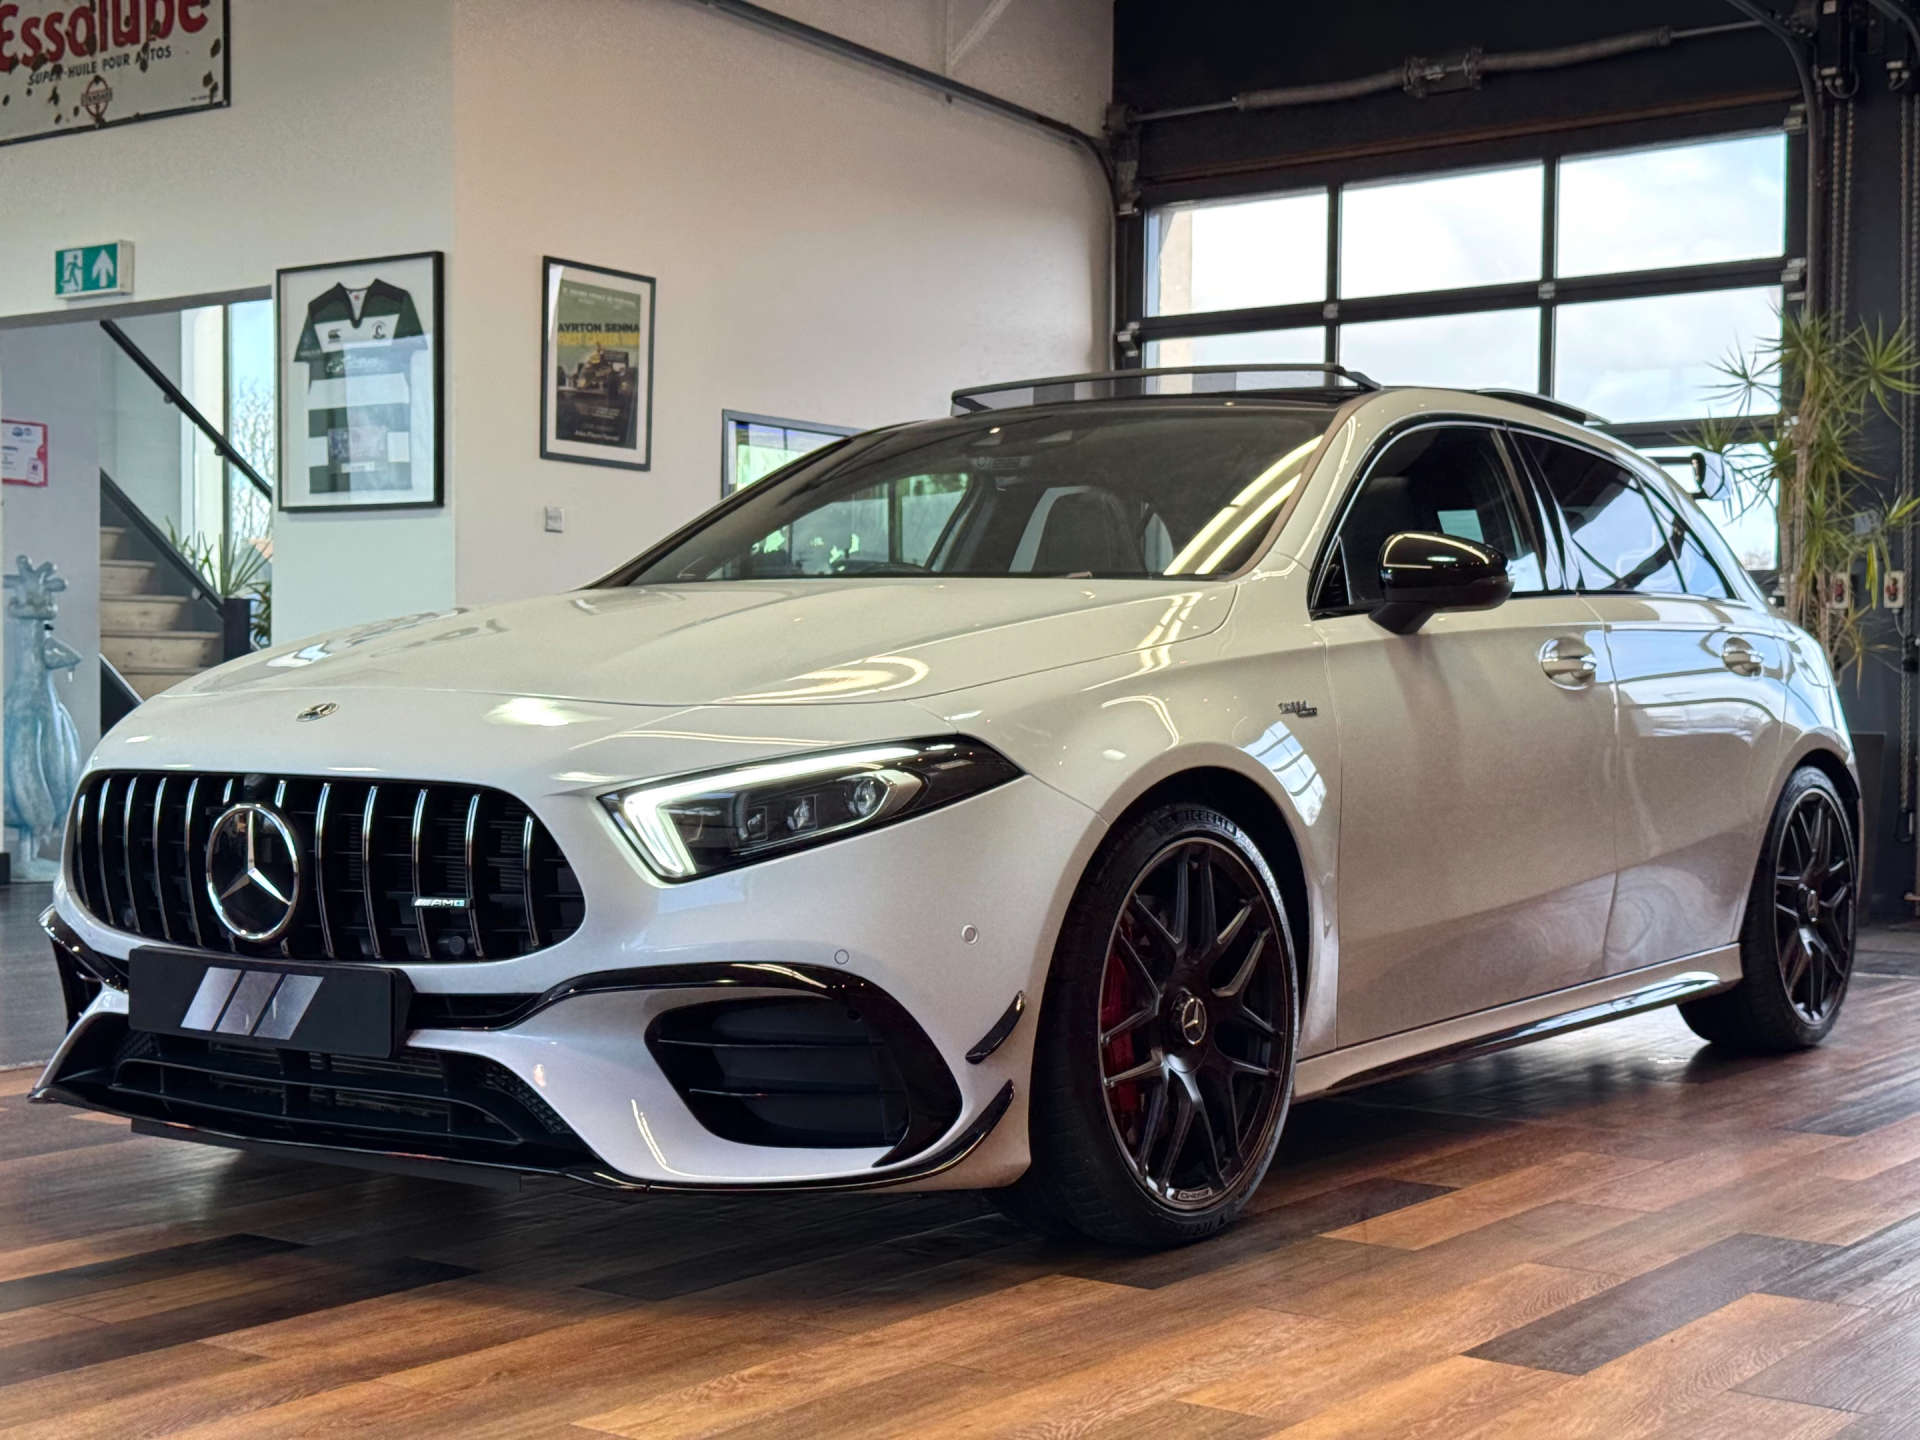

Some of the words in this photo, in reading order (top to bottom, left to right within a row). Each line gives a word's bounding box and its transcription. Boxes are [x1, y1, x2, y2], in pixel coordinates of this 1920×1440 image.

[102, 53, 131, 72] POUR
[558, 323, 602, 333] AYRTON
[604, 323, 640, 333] SENNA
